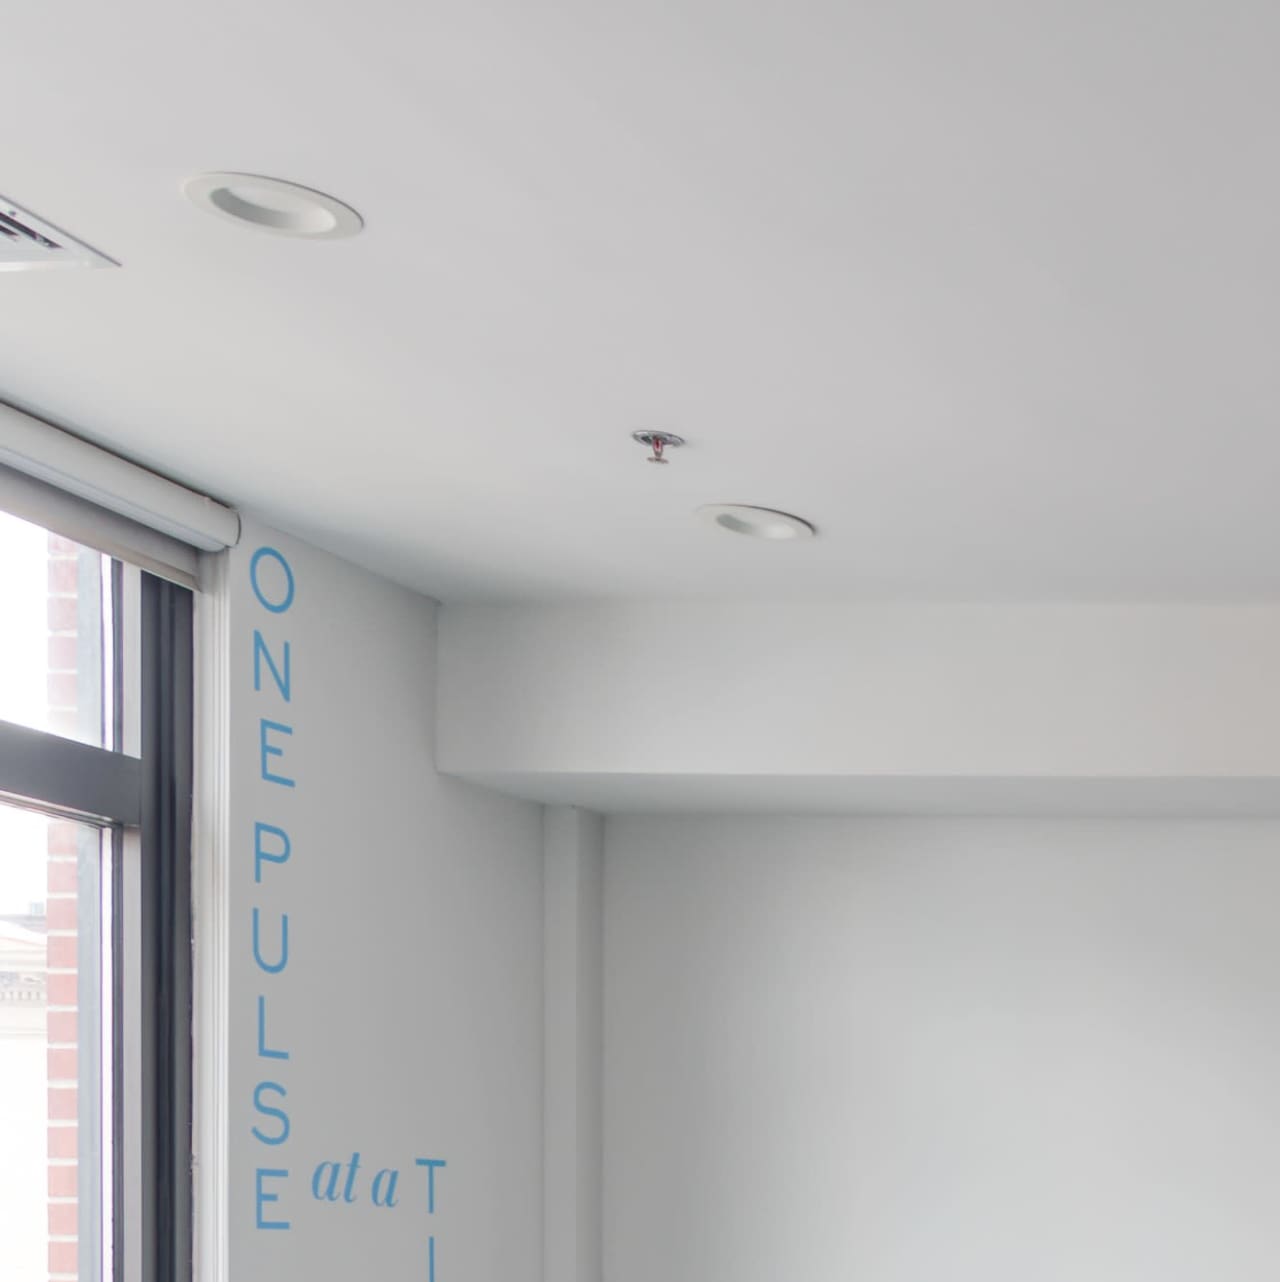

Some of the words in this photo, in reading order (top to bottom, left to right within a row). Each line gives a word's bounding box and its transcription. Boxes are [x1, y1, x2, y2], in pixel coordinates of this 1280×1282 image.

[249, 546, 296, 789] ONE
[250, 821, 292, 1230] PULSE
[311, 1150, 362, 1203] at
[371, 1167, 400, 1208] a
